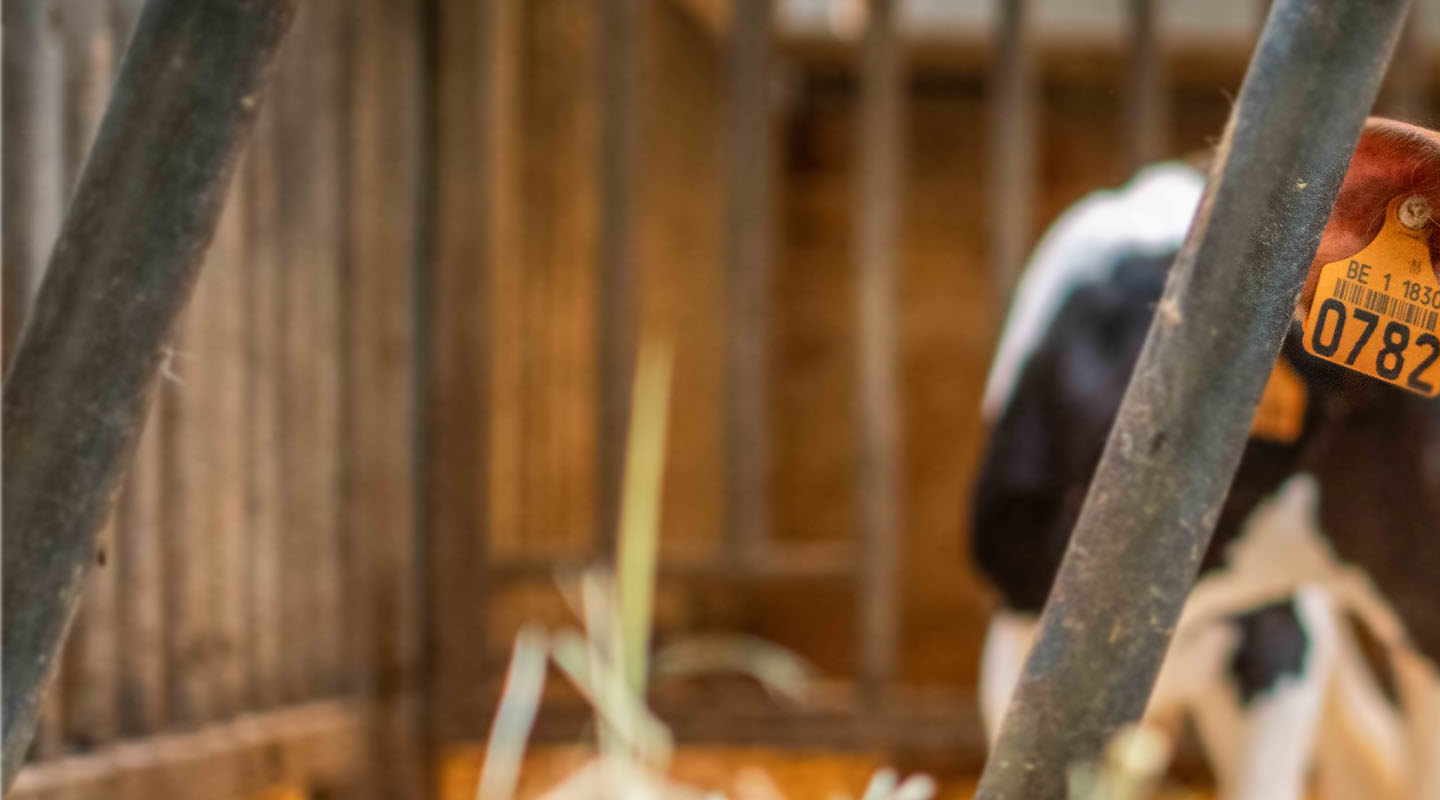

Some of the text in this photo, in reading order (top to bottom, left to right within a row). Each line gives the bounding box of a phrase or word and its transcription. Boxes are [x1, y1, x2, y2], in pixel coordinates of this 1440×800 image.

[1346, 260, 1371, 285] BE
[1383, 273, 1392, 291] 1
[1311, 297, 1440, 393] 0782
